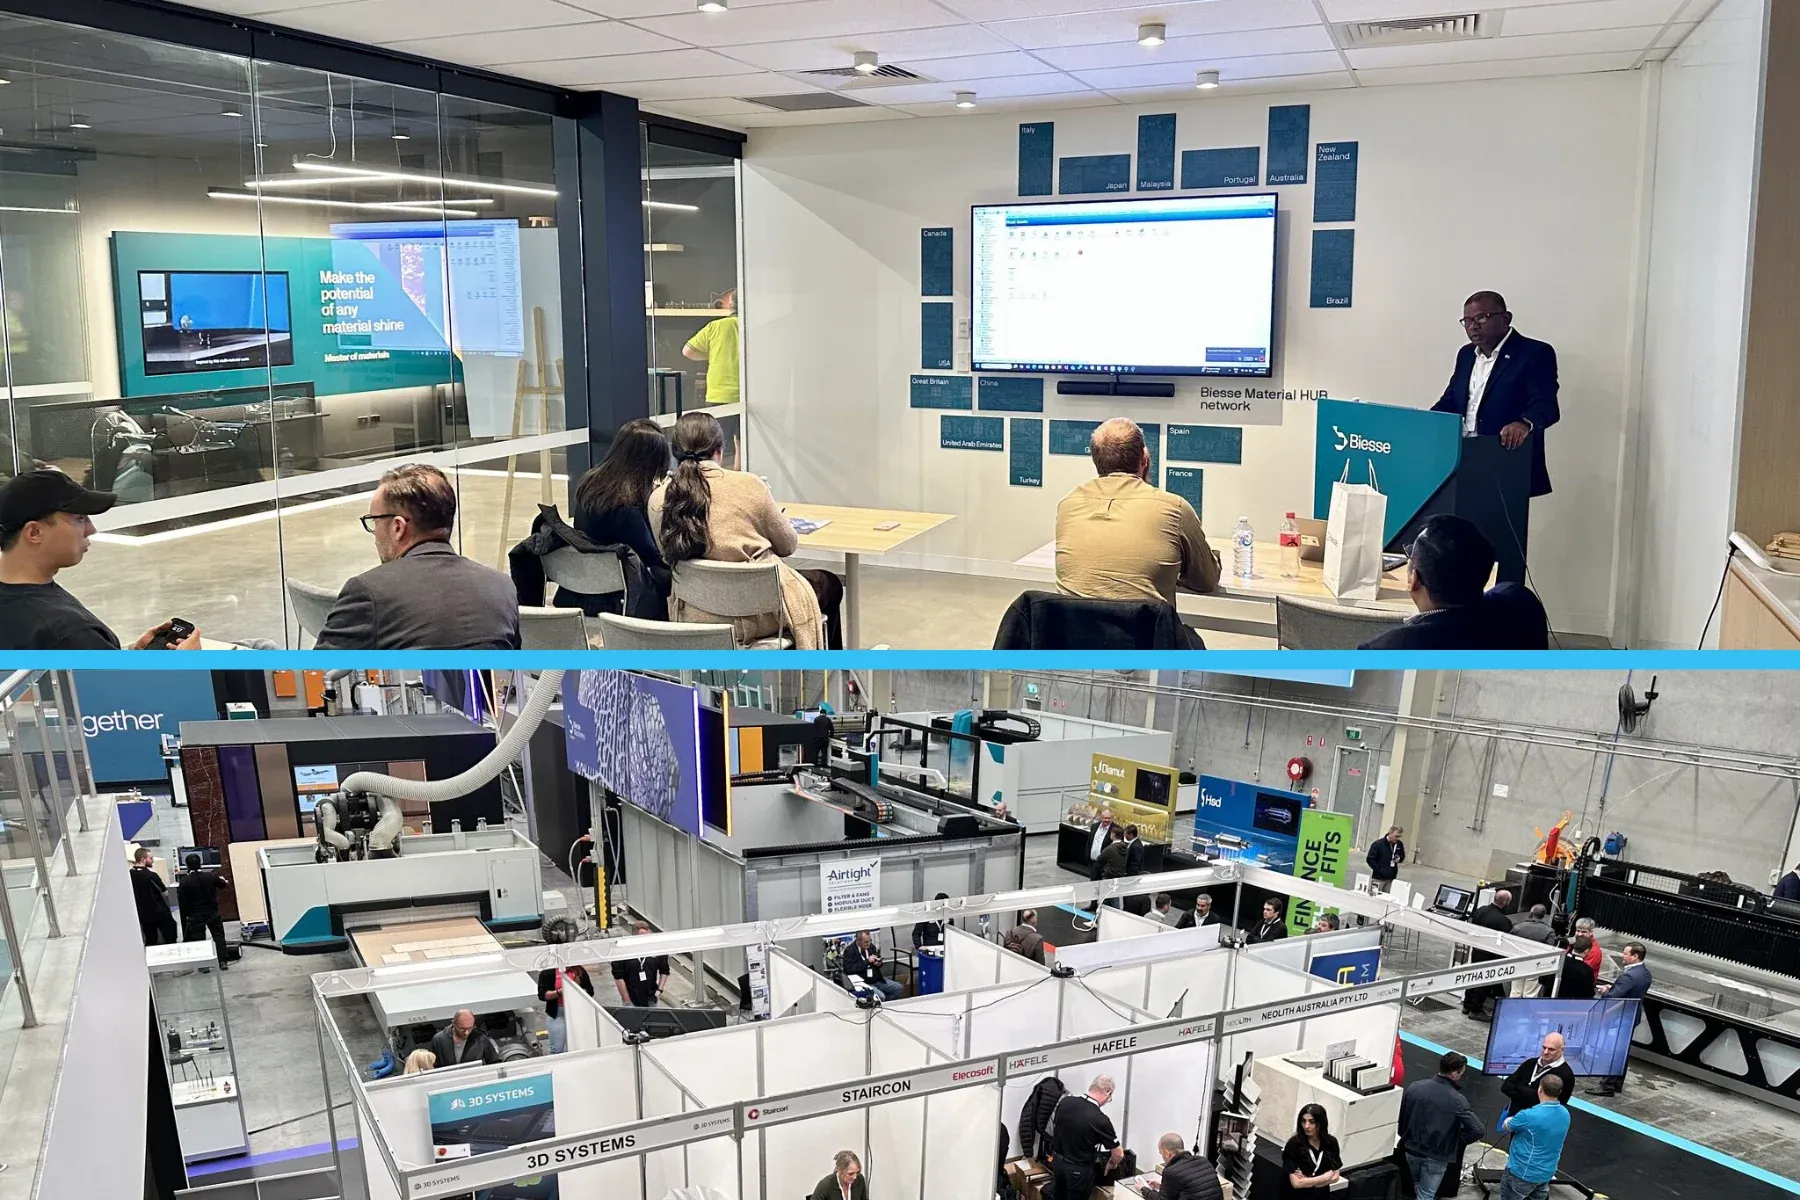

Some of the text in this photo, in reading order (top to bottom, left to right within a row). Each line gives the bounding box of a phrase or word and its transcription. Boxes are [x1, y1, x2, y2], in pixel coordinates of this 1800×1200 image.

[1021, 126, 1036, 134] Italy
[1318, 153, 1350, 161] Zealand
[1140, 180, 1171, 189] Malaysia
[1224, 176, 1256, 185] Portugal
[1269, 174, 1304, 182] Australia
[1106, 182, 1127, 190] Japan
[319, 270, 376, 284] Make the
[320, 286, 374, 303] potential
[1326, 296, 1349, 304] Brazil
[321, 303, 358, 318] of any
[322, 319, 404, 333] material shine
[911, 377, 928, 385] Great
[979, 379, 998, 387] China
[1200, 386, 1242, 399] Biesse
[1244, 388, 1296, 401] Material
[1200, 400, 1251, 411] network
[1169, 427, 1190, 436] Spain
[976, 441, 1003, 449] Emirates
[1350, 433, 1391, 454] Biesse
[1168, 469, 1193, 477] France
[1019, 476, 1040, 485] Turkey
[82, 709, 163, 737] gether
[1102, 763, 1125, 778] Diamut
[1205, 794, 1222, 808] Hsd
[1320, 831, 1341, 874] FITS
[826, 867, 871, 881] Airtight
[1293, 839, 1322, 928] FINNCE
[1455, 965, 1516, 984] PYTHA 3D CAD
[1261, 992, 1368, 1021] NEOLITH AUSTRALIA PTY LTD
[1092, 1036, 1137, 1054] HAFELE
[952, 1064, 995, 1081] Elecosoft
[468, 1086, 535, 1107] 3D SYSTEMS
[842, 1080, 911, 1103] STAIRCON
[763, 1106, 788, 1115] Staircon
[708, 1118, 730, 1127] SYSTEMS
[527, 1134, 635, 1169] 3D SYSTEMS
[432, 1175, 461, 1186] SYSTEMS
